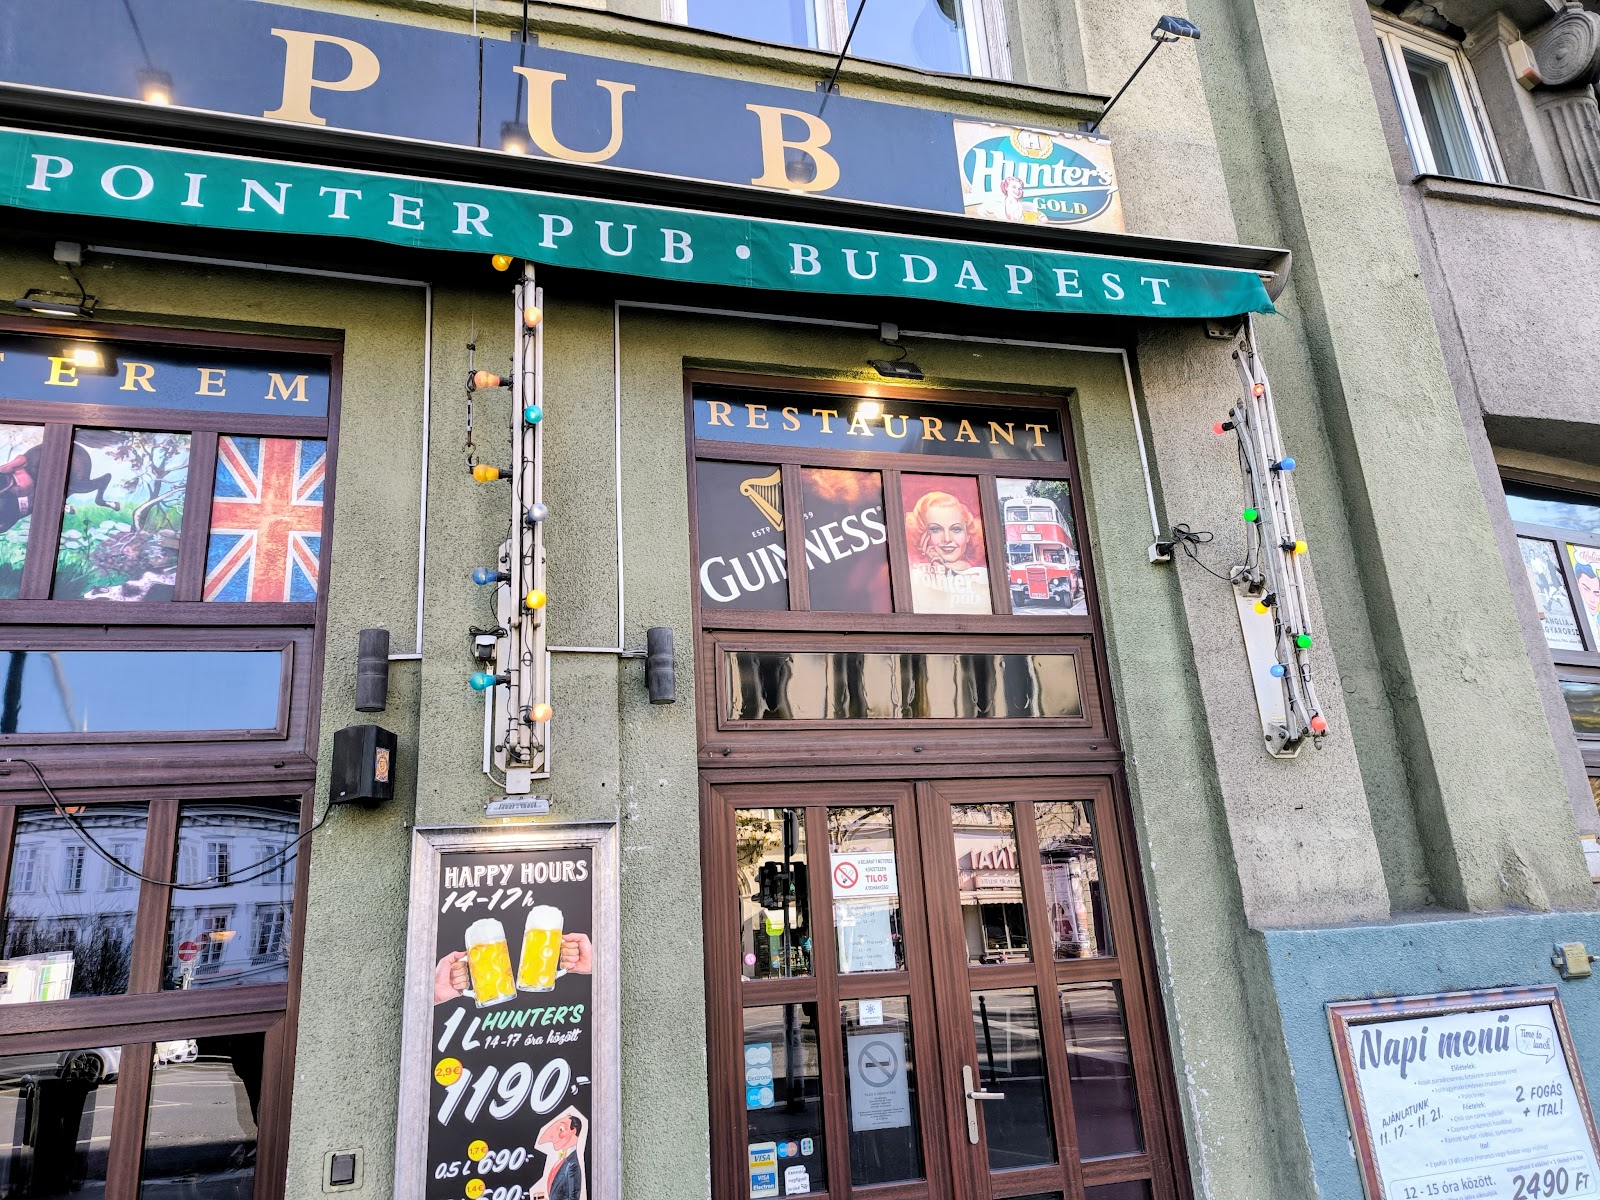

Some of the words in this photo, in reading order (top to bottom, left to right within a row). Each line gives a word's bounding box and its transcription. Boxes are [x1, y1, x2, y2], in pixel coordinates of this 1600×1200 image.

[264, 28, 841, 193] PUB
[972, 148, 1112, 193] Hunter's
[1032, 197, 1088, 215] GOLD
[26, 153, 493, 237] POINTER
[538, 213, 695, 264] PUB
[789, 242, 1170, 306] BUDAPEST
[0, 353, 309, 402] EREM
[706, 400, 1049, 447] RESTAURANT
[445, 863, 514, 888] HAPPY
[521, 860, 588, 885] HOURS
[865, 874, 888, 883] TILOS
[481, 1003, 585, 1031] HUNTER'S
[524, 1035, 543, 1047] óra
[546, 1029, 583, 1047] között
[1359, 1025, 1429, 1080] Napi
[1437, 1014, 1510, 1060] menü
[1515, 1085, 1526, 1102] 2
[1530, 1080, 1562, 1100] FOGÁS
[1382, 1098, 1429, 1128] AJÁNLATUNK
[1537, 1099, 1563, 1118] ITAL!
[754, 1154, 771, 1162] VISA
[1404, 1186, 1418, 1200] 12
[1427, 1182, 1440, 1196] 15
[1442, 1179, 1460, 1194] óra
[1512, 1167, 1569, 1200] 2490
